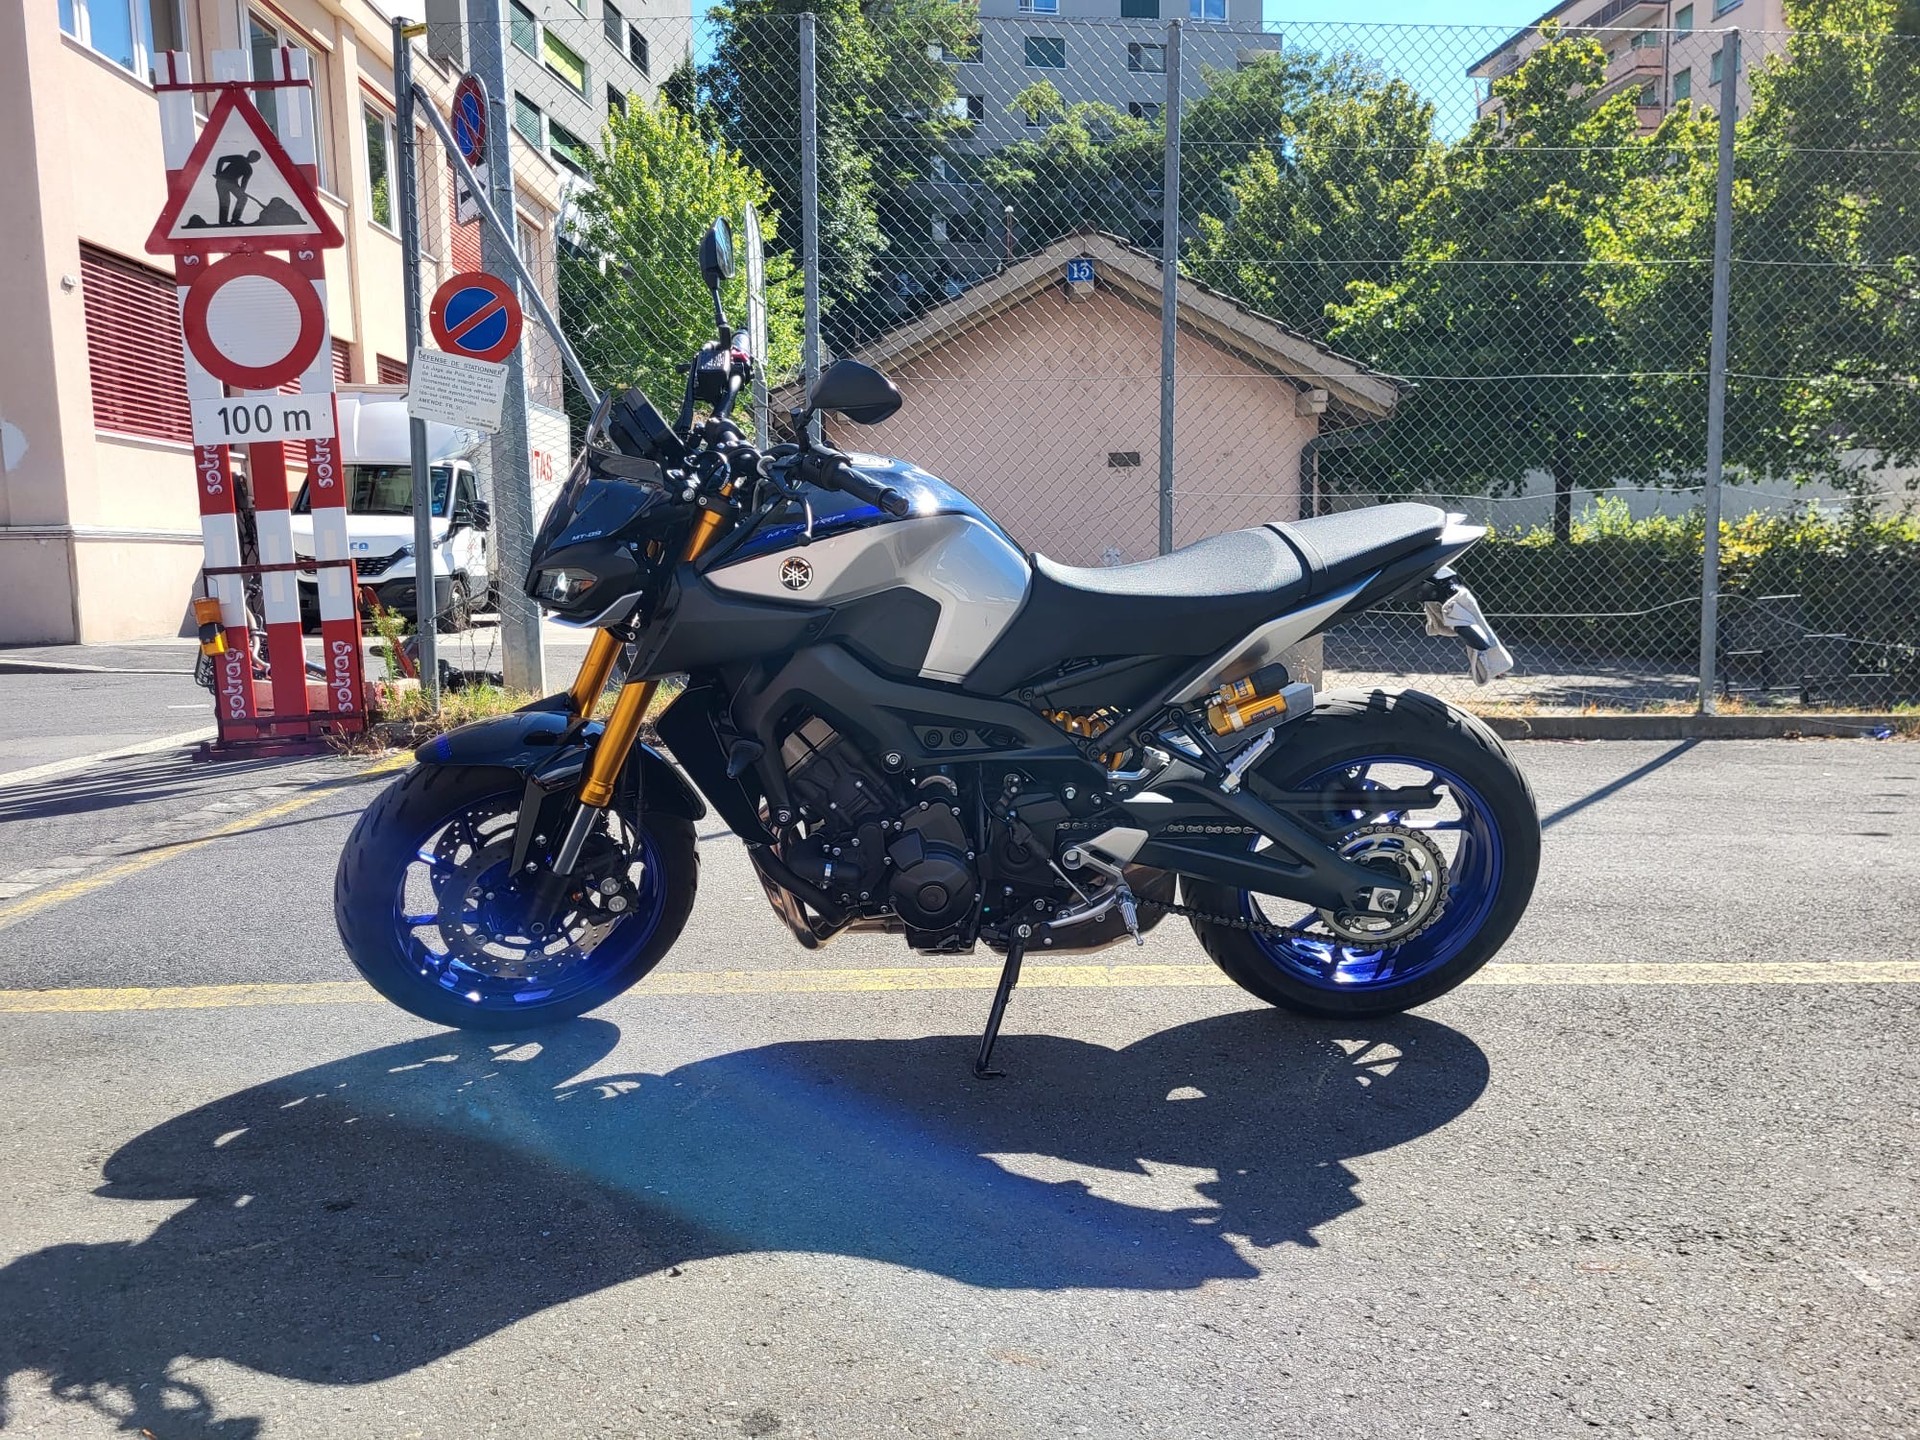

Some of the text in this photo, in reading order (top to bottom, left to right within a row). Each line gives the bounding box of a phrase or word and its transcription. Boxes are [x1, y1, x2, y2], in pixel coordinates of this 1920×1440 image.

[217, 404, 311, 436] 100 m
[418, 397, 442, 406] AMENDE
[199, 445, 223, 496] sotr
[310, 438, 334, 489] sotr
[571, 530, 602, 541] MT-09
[223, 647, 246, 720] sotrag
[330, 640, 353, 712] sotrag
